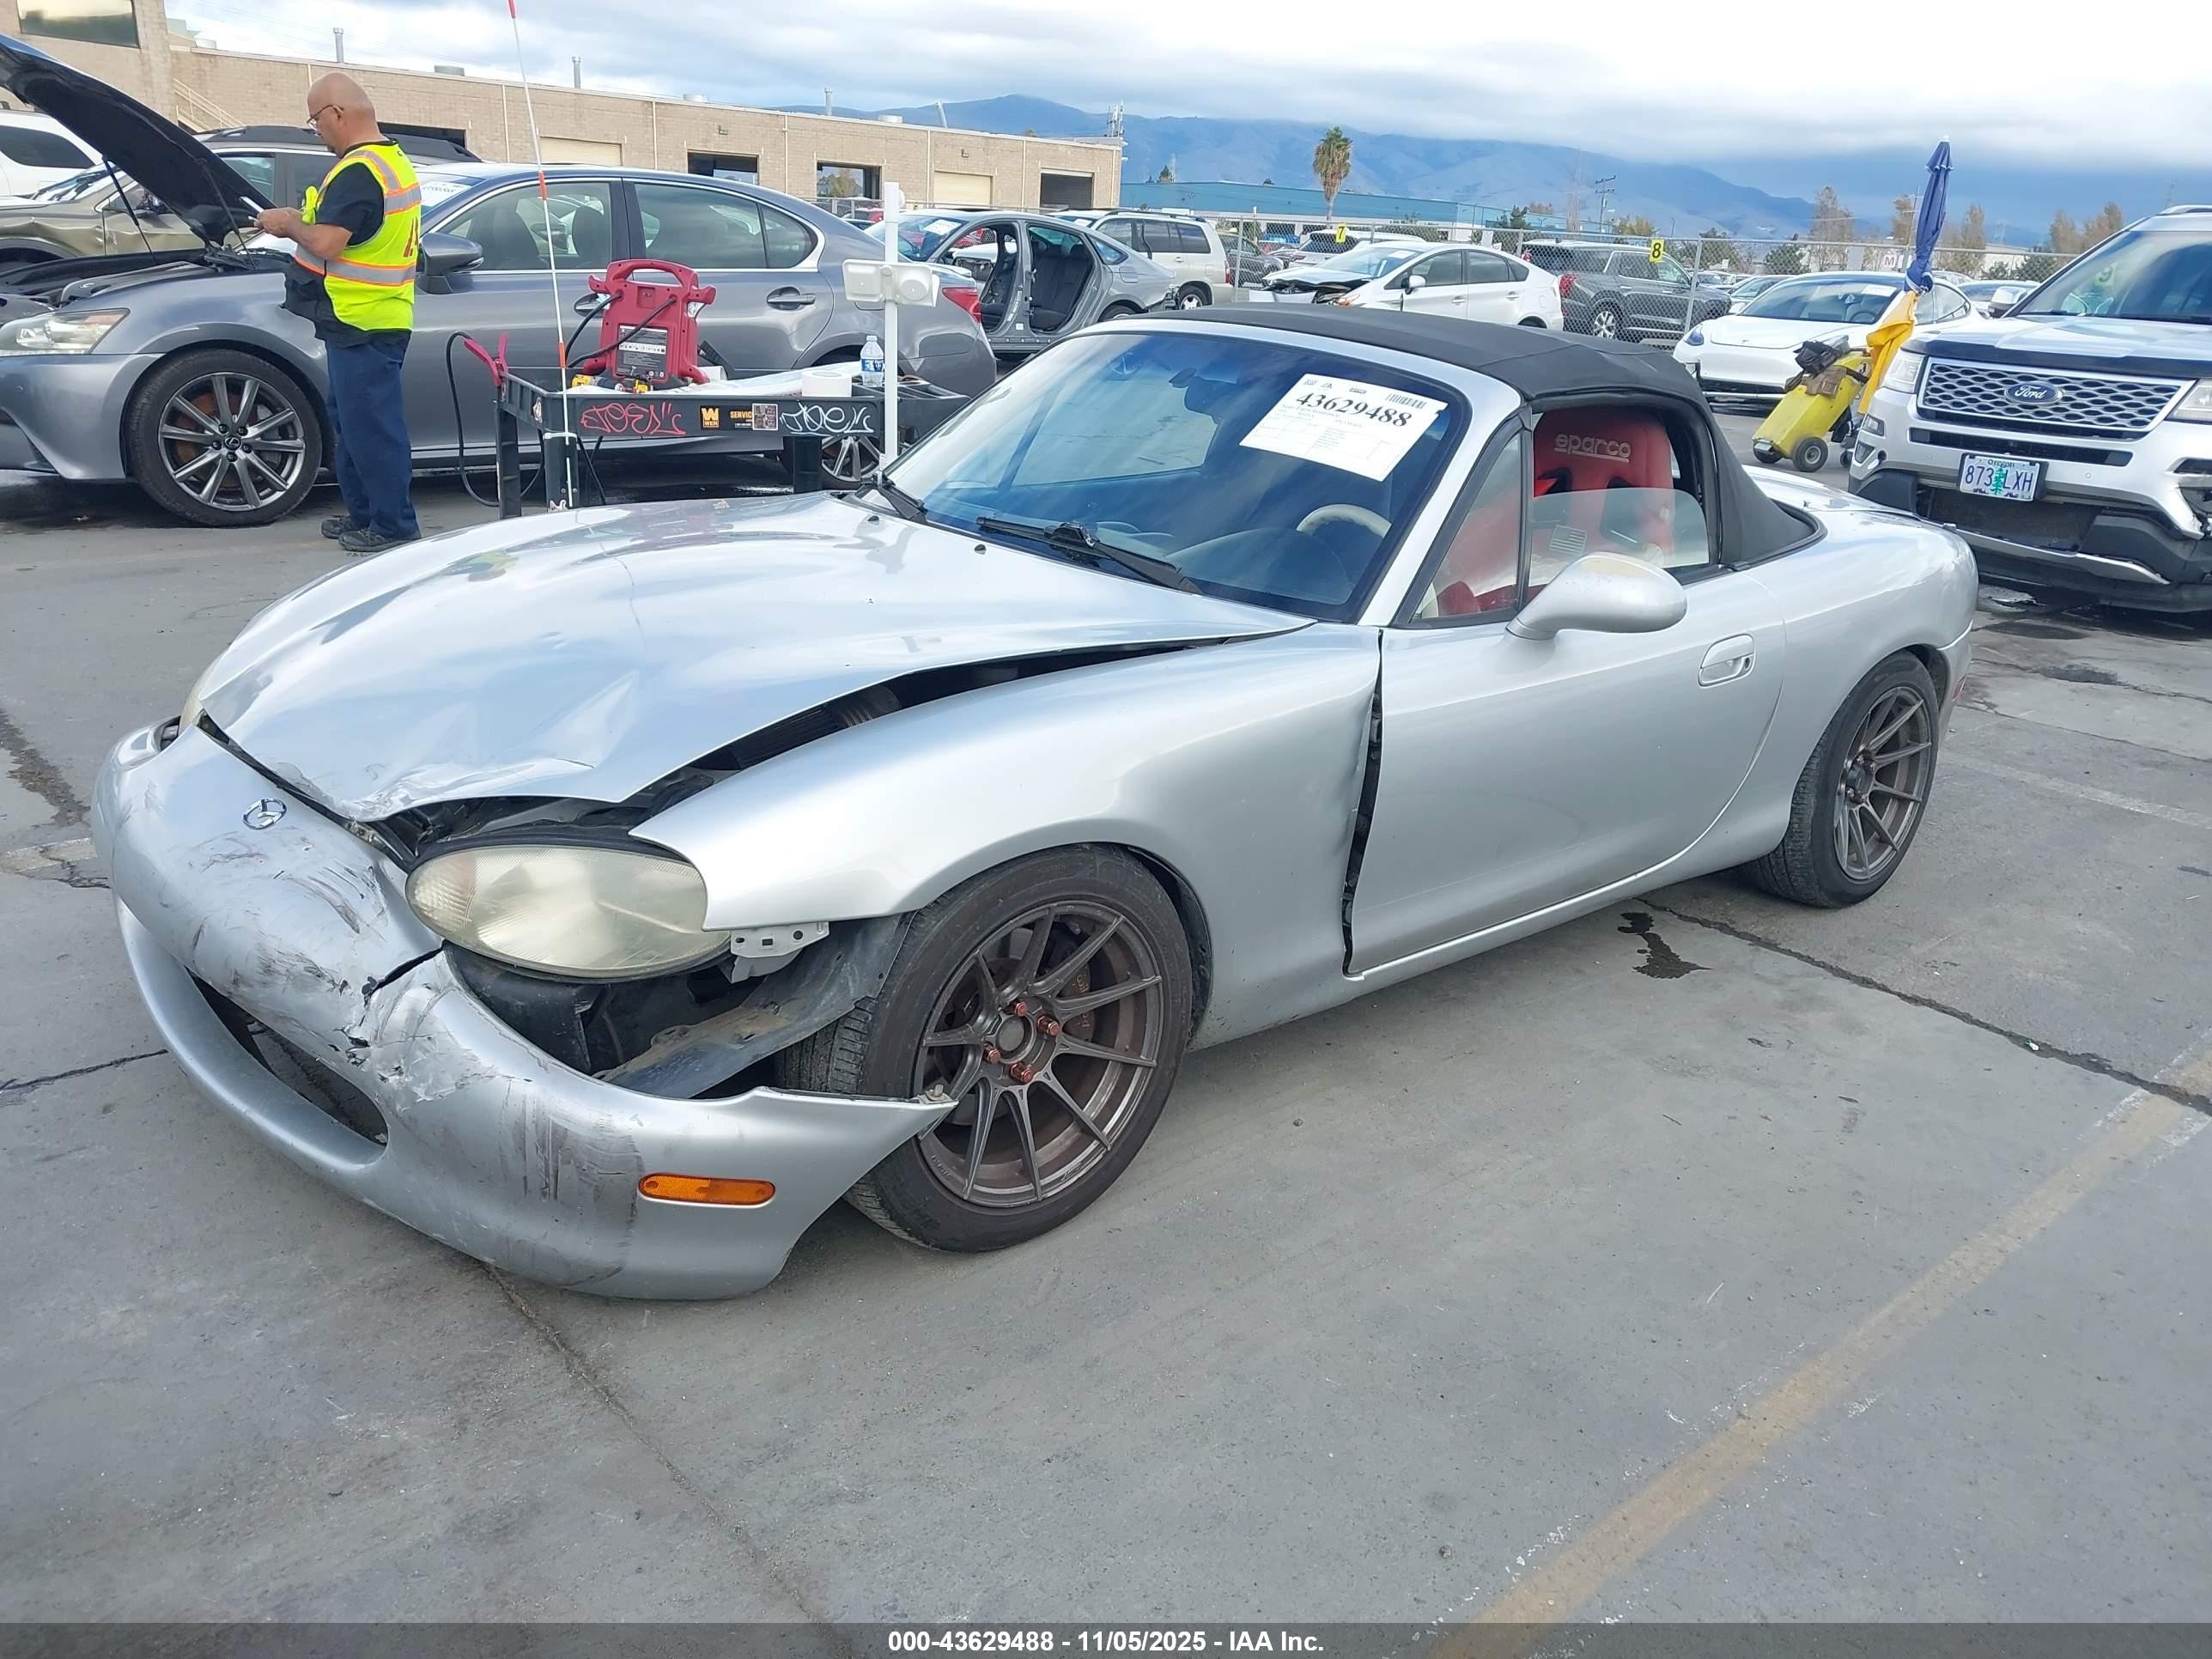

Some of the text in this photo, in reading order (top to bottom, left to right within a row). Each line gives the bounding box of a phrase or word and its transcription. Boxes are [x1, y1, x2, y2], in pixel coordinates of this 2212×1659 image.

[1338, 226, 1346, 240] 7
[1651, 241, 1662, 259] 8
[2014, 384, 2048, 400] Ford
[730, 410, 753, 419] SERVIC
[1296, 392, 1413, 428] 43629488
[1554, 433, 1632, 459] sparco
[1987, 459, 2015, 469] Oregon
[1965, 465, 2034, 493] 873 LXH
